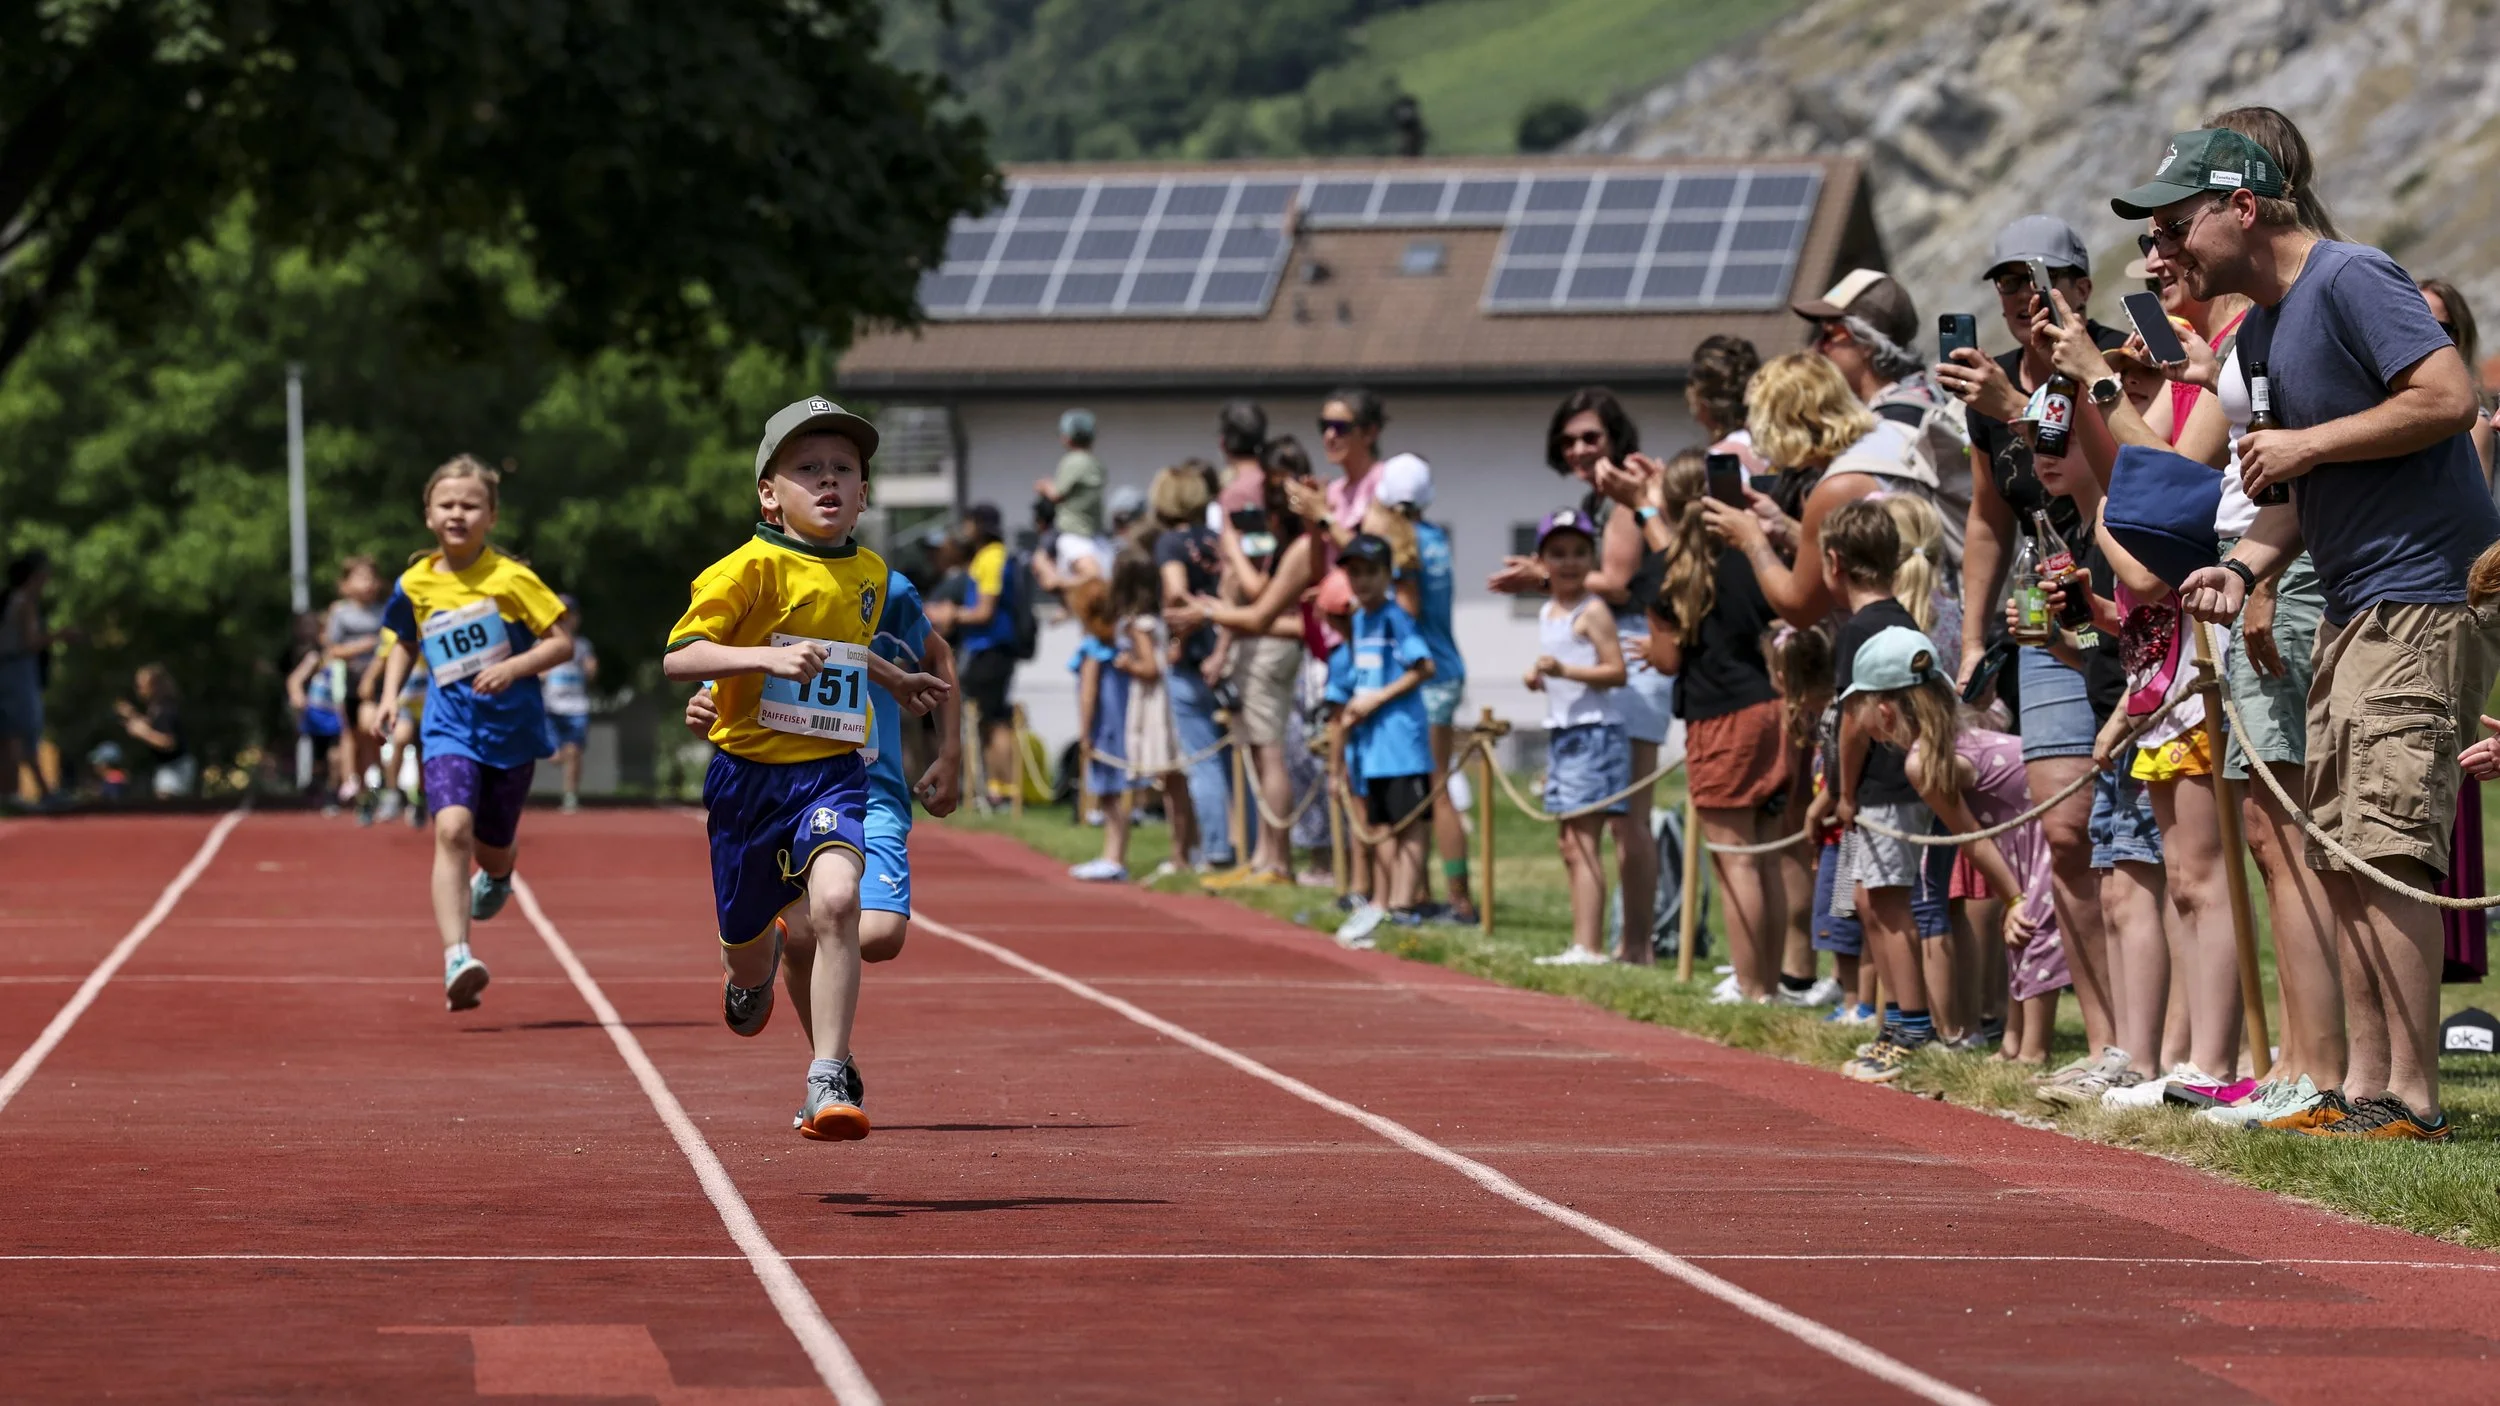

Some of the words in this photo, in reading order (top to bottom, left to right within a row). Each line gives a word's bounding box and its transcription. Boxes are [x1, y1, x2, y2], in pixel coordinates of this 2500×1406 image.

[437, 623, 488, 659] 169
[798, 667, 859, 709] 151
[761, 709, 807, 725] RAIFFEISEN
